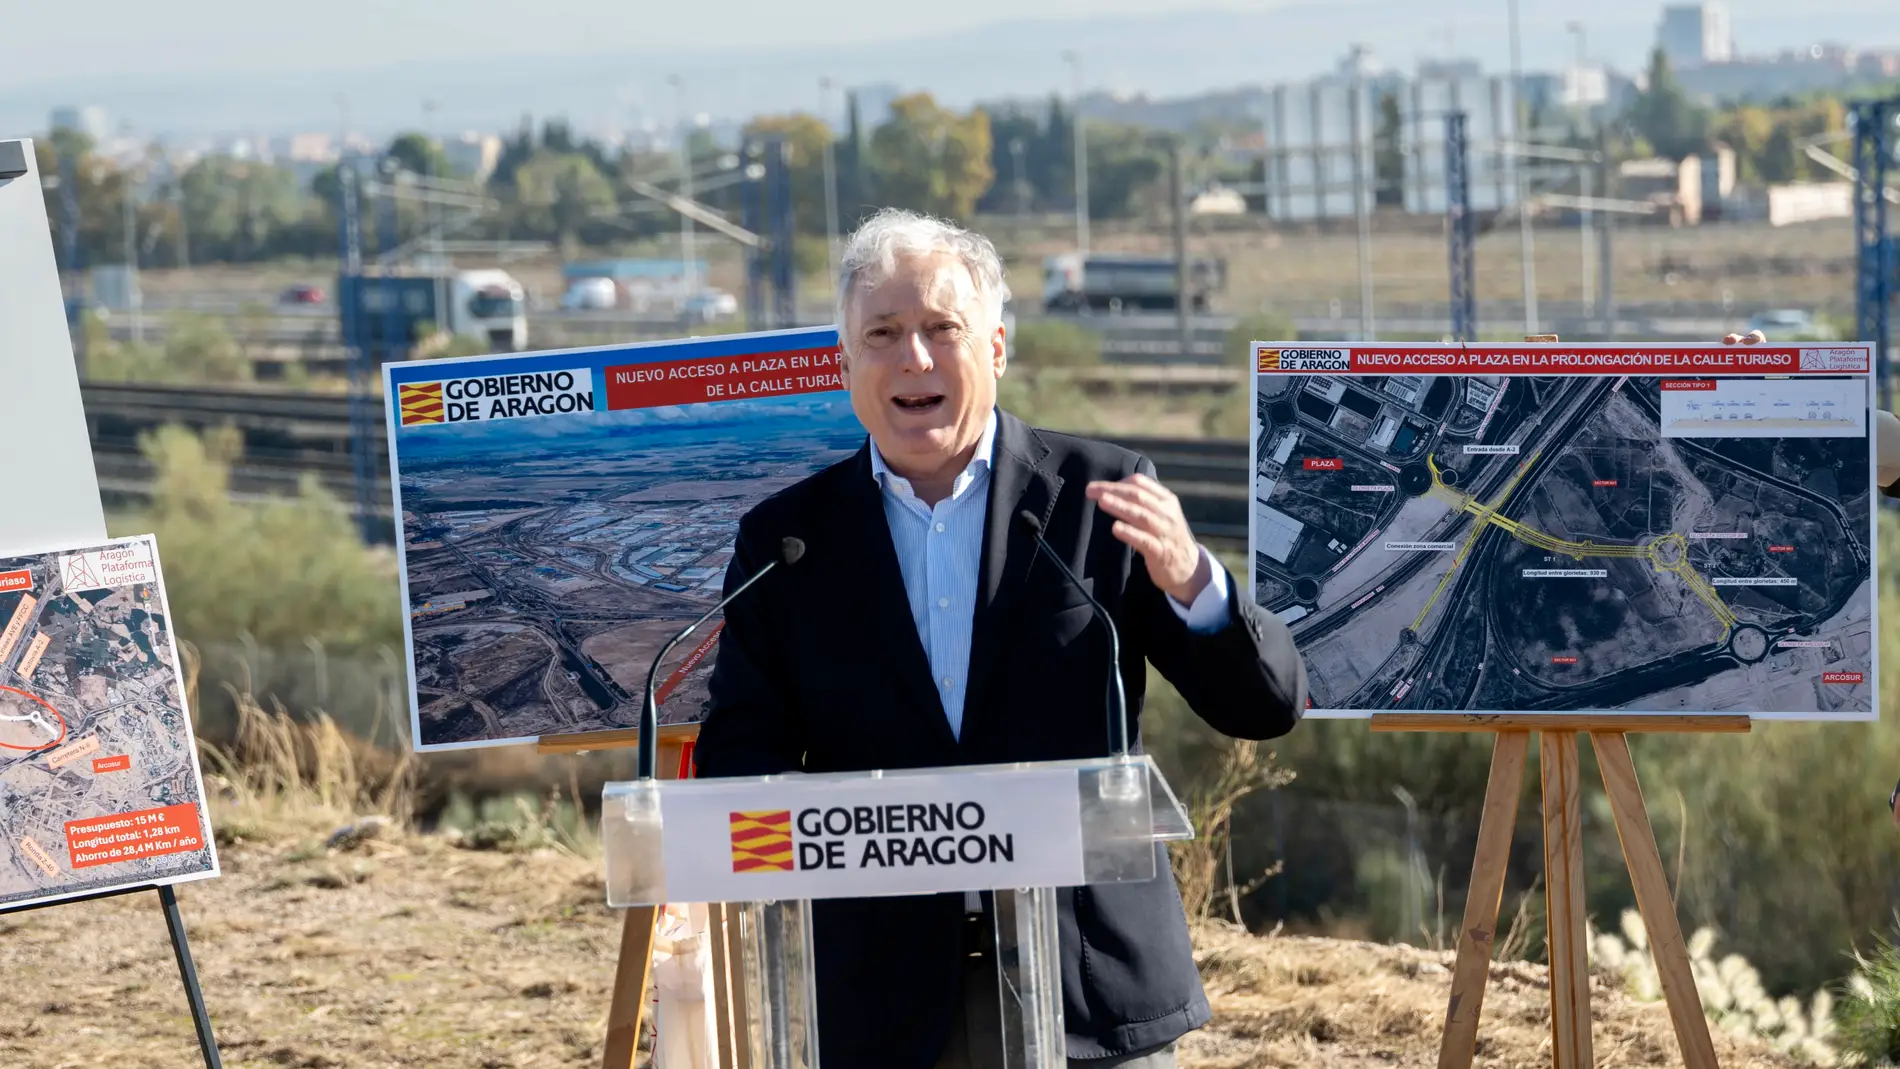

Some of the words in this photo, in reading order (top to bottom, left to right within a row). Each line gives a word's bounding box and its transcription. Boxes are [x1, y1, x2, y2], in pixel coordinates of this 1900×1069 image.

[1280, 360, 1297, 370] DE
[1300, 360, 1350, 370] ARAGON
[1281, 349, 1342, 360] GOBIERNO
[1357, 354, 1401, 365] NUEVO
[1402, 354, 1456, 365] ACCESO
[1457, 354, 1468, 365] A
[1469, 354, 1510, 365] PLAZA
[1512, 354, 1530, 365] EN
[1531, 354, 1549, 365] LA
[1551, 352, 1651, 365] PROLONGACIÓN
[1654, 354, 1672, 365] DE
[1674, 354, 1690, 365] LA
[1692, 354, 1734, 365] CALLE
[1736, 354, 1792, 365] TURIASO
[616, 369, 665, 384] NUEVO
[668, 363, 725, 380] ACCESO
[729, 362, 740, 374] A
[743, 358, 787, 373] PLAZA
[791, 355, 809, 369] EN
[813, 354, 831, 366] LA
[445, 371, 574, 400] GOBIERNO
[706, 383, 724, 397] DE
[729, 382, 746, 395] LA
[750, 379, 793, 393] CALLE
[797, 374, 843, 389] TURIA
[1665, 381, 1692, 389] SECCIÓN
[447, 401, 480, 422] DE
[489, 391, 594, 419] ARAGON
[101, 560, 153, 573] Plataforma
[679, 653, 701, 674] Nuevo
[52, 748, 79, 763] Carretera
[97, 761, 121, 769] Arcosur
[70, 819, 134, 835] Presupuesto:
[135, 815, 147, 825] 15
[147, 813, 157, 823] M
[158, 812, 165, 822] €
[797, 801, 985, 838] GOBIERNO
[72, 834, 115, 849] Longitud
[116, 830, 142, 842] total:
[143, 827, 164, 839] 1,28
[164, 825, 180, 835] km
[26, 841, 42, 861] Ronda
[75, 851, 109, 863] Ahorro
[110, 848, 122, 857] de
[123, 843, 144, 855] 28,4
[145, 842, 154, 852] M
[155, 840, 172, 850] Km
[179, 836, 198, 847] año
[799, 840, 846, 871] DE
[859, 833, 1015, 869] ARAGON
